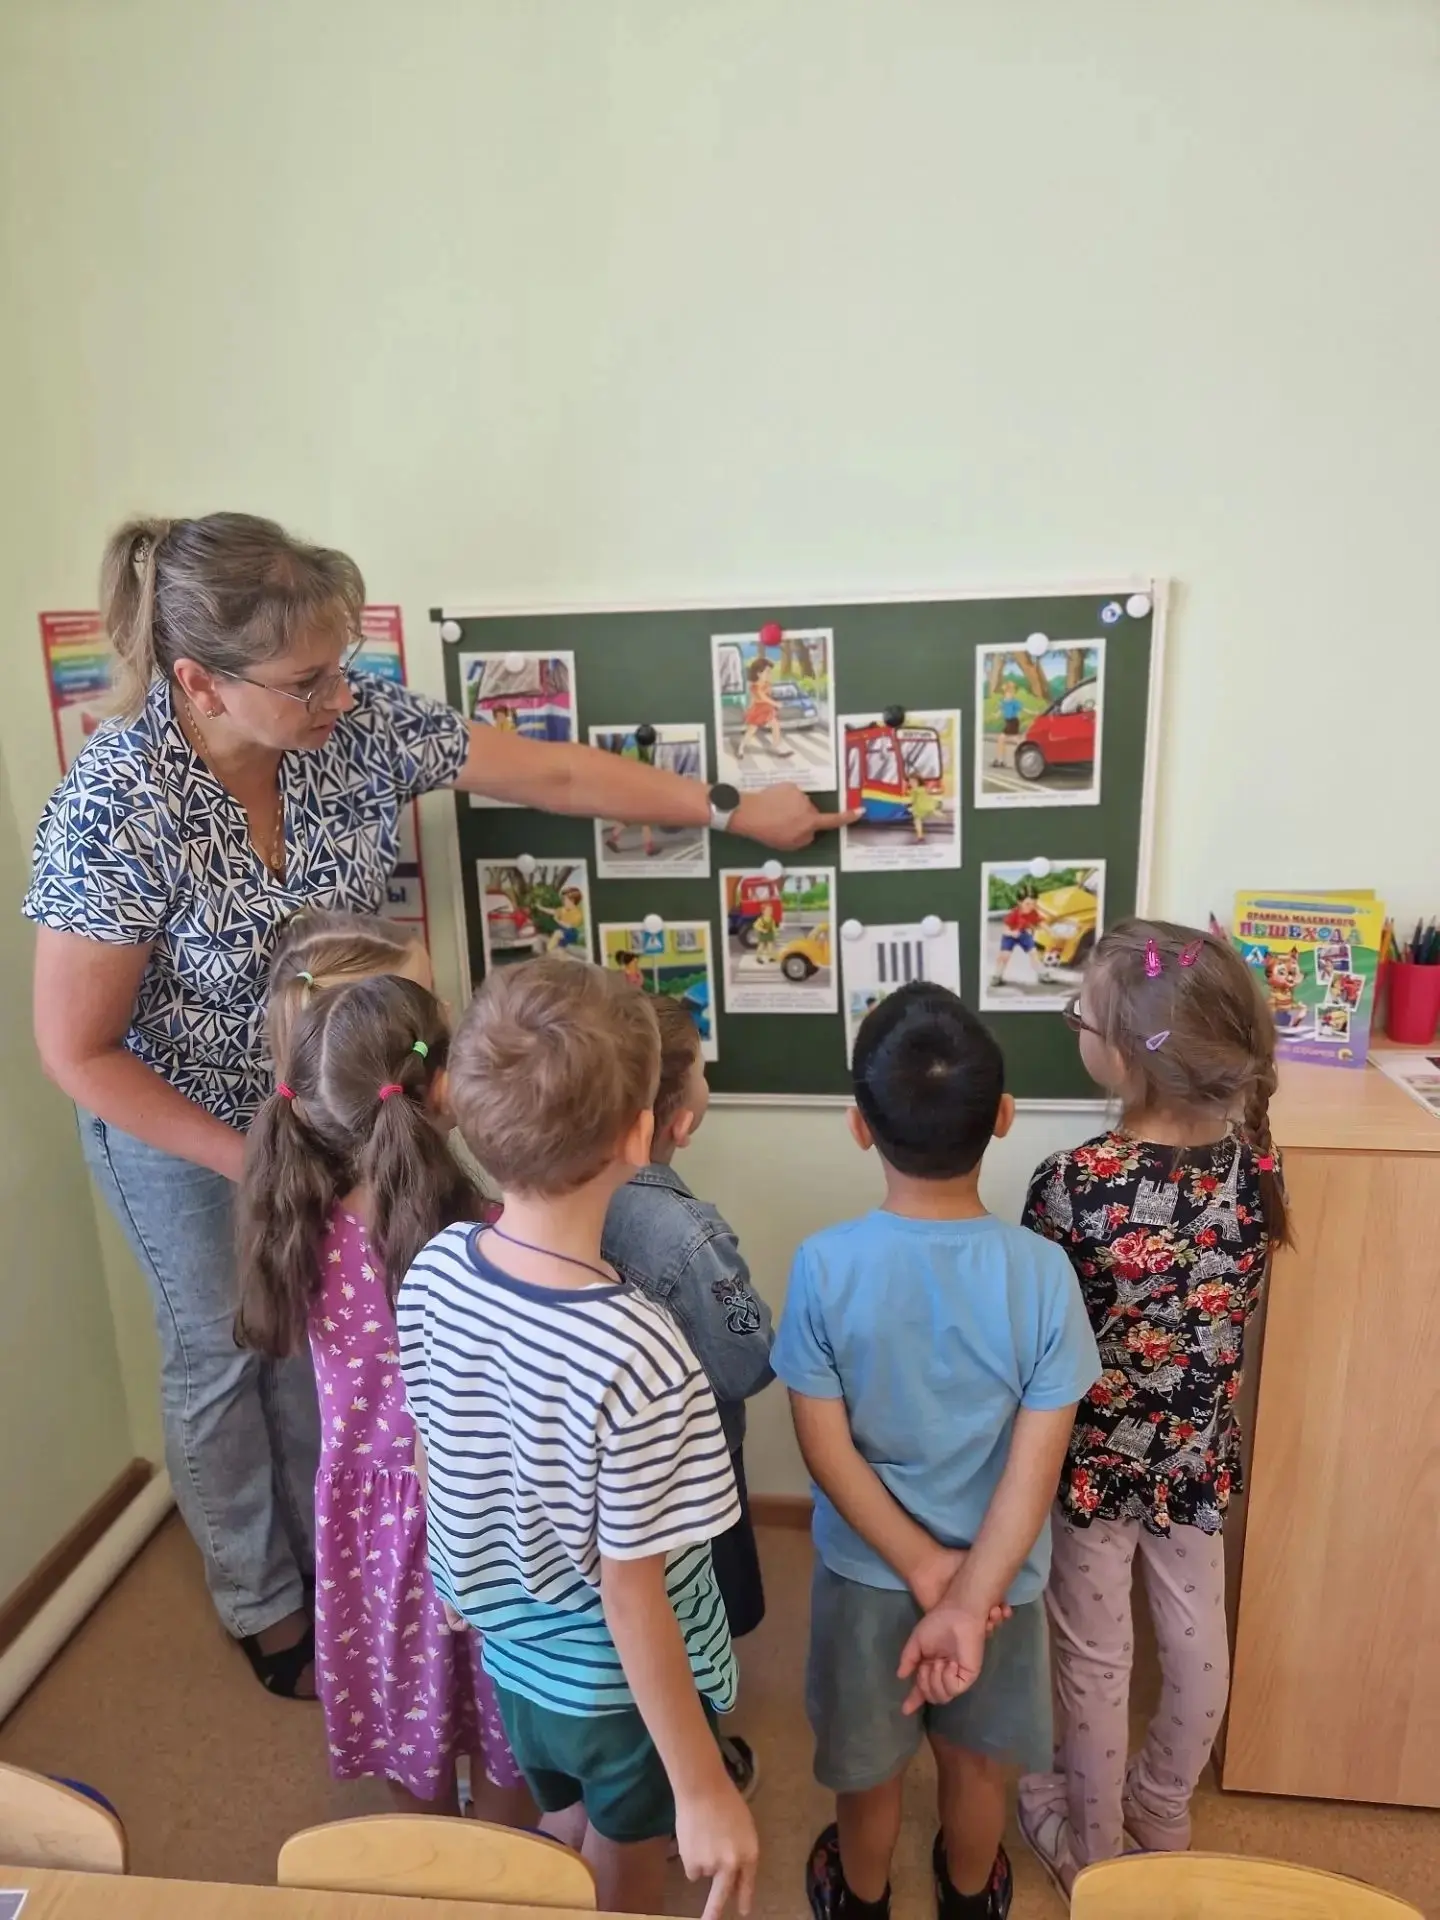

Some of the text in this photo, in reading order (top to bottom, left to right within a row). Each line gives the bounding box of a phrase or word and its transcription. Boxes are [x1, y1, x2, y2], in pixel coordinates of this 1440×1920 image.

[1246, 911, 1356, 927] ПРАВИЛА МАЛЕНЬКОГО
[1239, 921, 1363, 945] ПЕШЕХОДА
